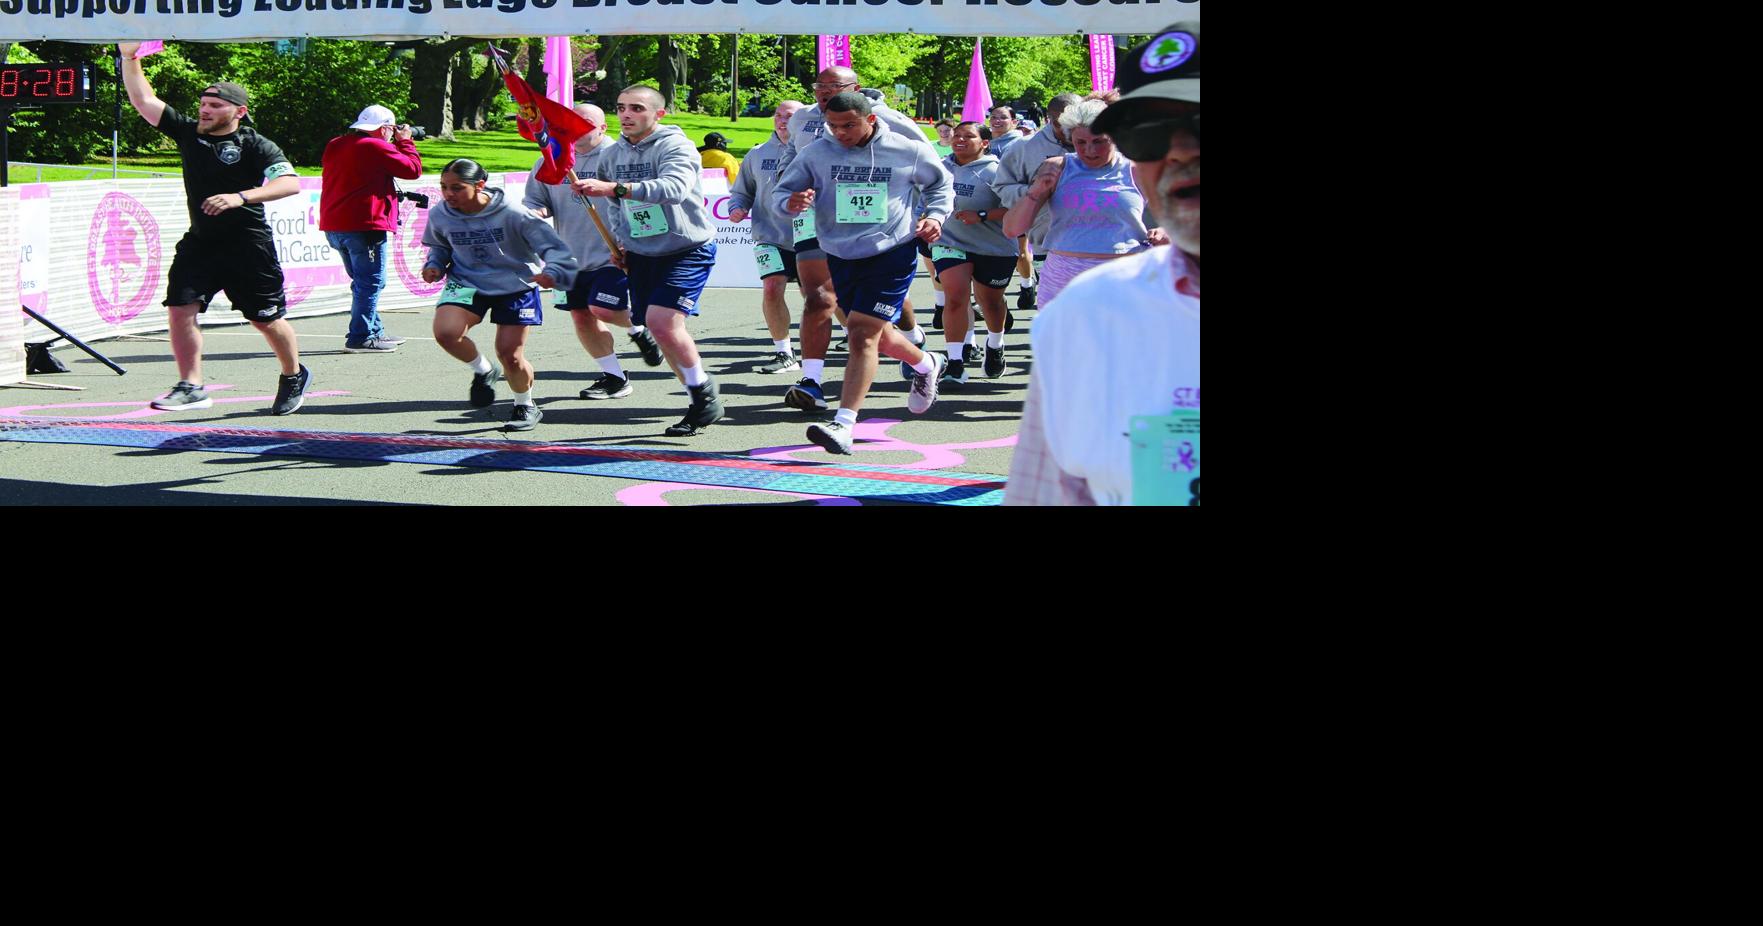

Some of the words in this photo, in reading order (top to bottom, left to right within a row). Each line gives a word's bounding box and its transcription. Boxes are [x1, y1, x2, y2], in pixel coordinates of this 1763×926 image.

[850, 195, 873, 206] 412
[632, 210, 651, 222] 454
[269, 210, 306, 236] ford
[716, 226, 752, 234] unting
[277, 240, 331, 263] hCare
